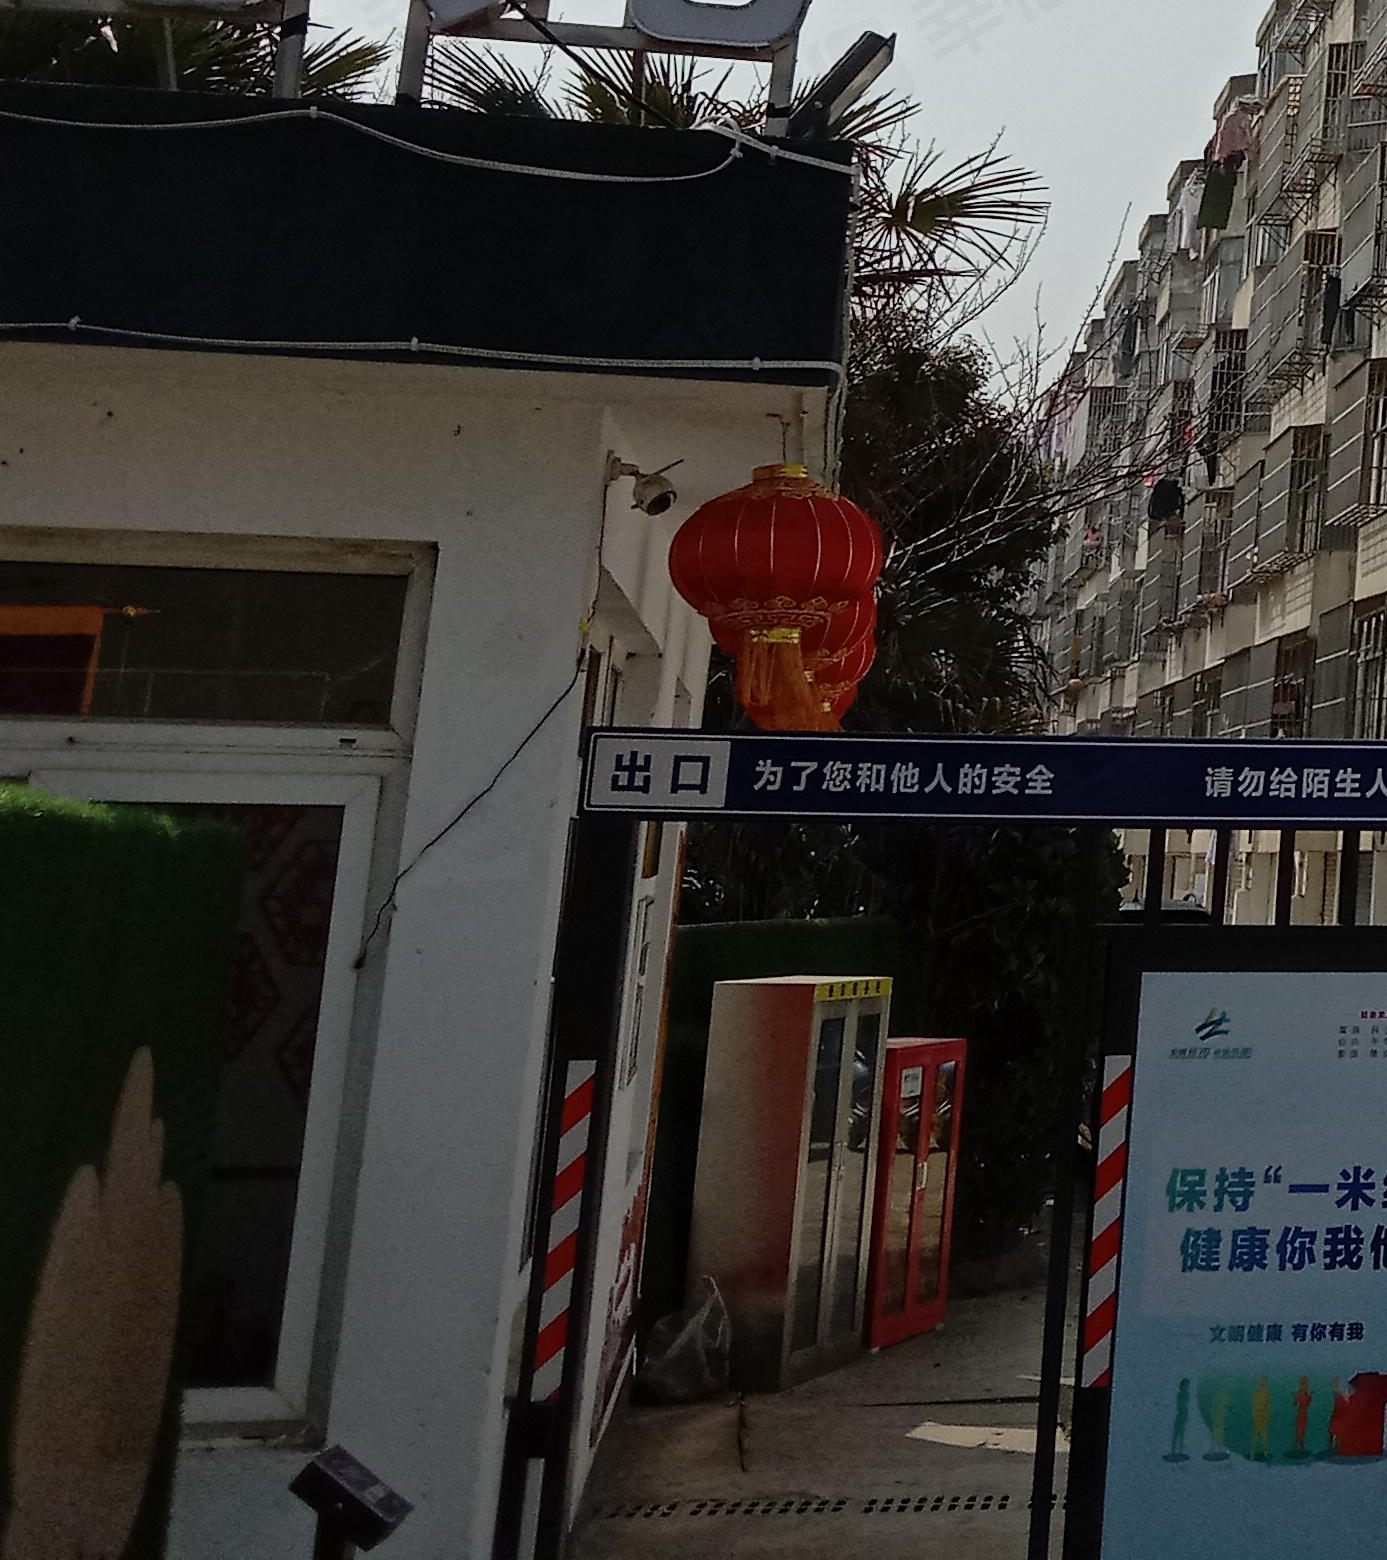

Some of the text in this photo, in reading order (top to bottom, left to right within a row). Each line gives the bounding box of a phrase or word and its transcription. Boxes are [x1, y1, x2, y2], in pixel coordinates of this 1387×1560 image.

[611, 750, 711, 795] 出口
[753, 759, 1056, 796] 为了您和他人的安全
[1208, 1321, 1365, 1344] 文明健康 有你有我
